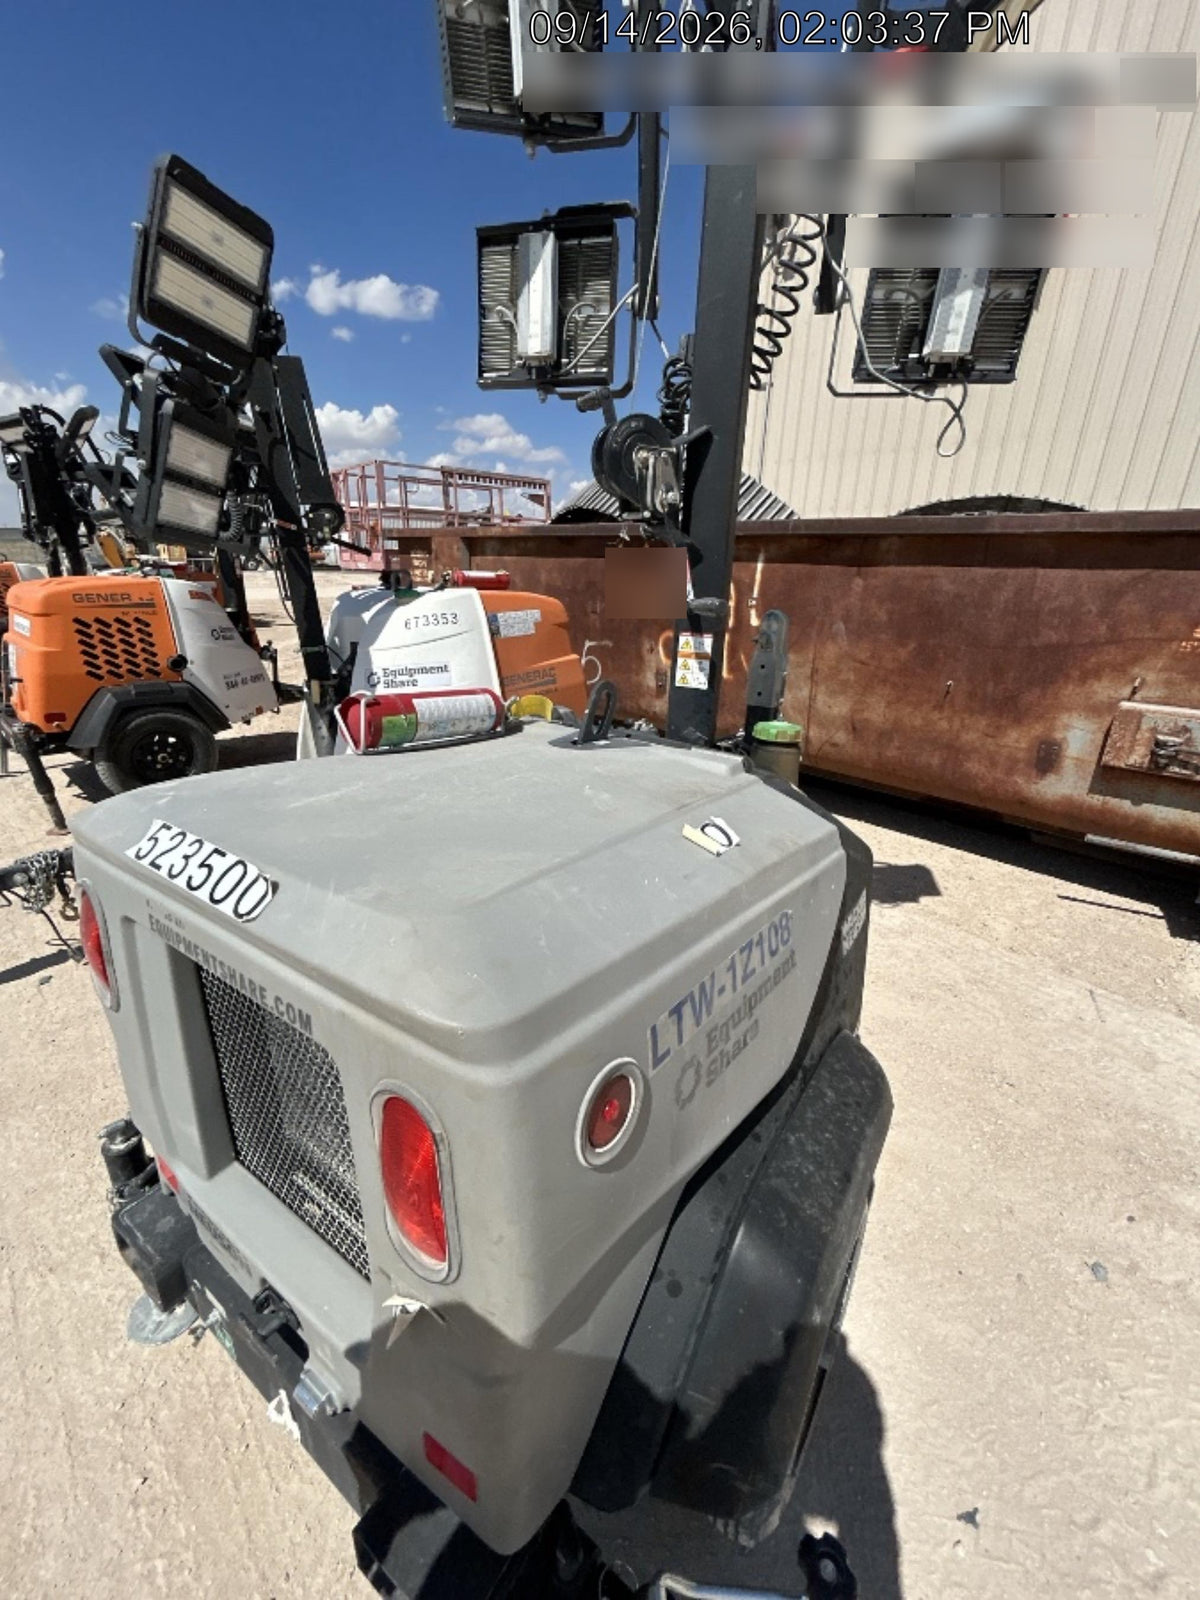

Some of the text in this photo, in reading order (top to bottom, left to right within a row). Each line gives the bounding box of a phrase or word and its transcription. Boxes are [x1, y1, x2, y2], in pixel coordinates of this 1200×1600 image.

[404, 612, 460, 631] 673353
[382, 663, 450, 680] Equipment
[382, 678, 418, 690] Share
[135, 822, 270, 920] 523500
[148, 914, 313, 1035] EQUIPMENTSHARE.COM
[649, 911, 792, 1070] LTW-1Z108
[707, 949, 797, 1056] Equipment
